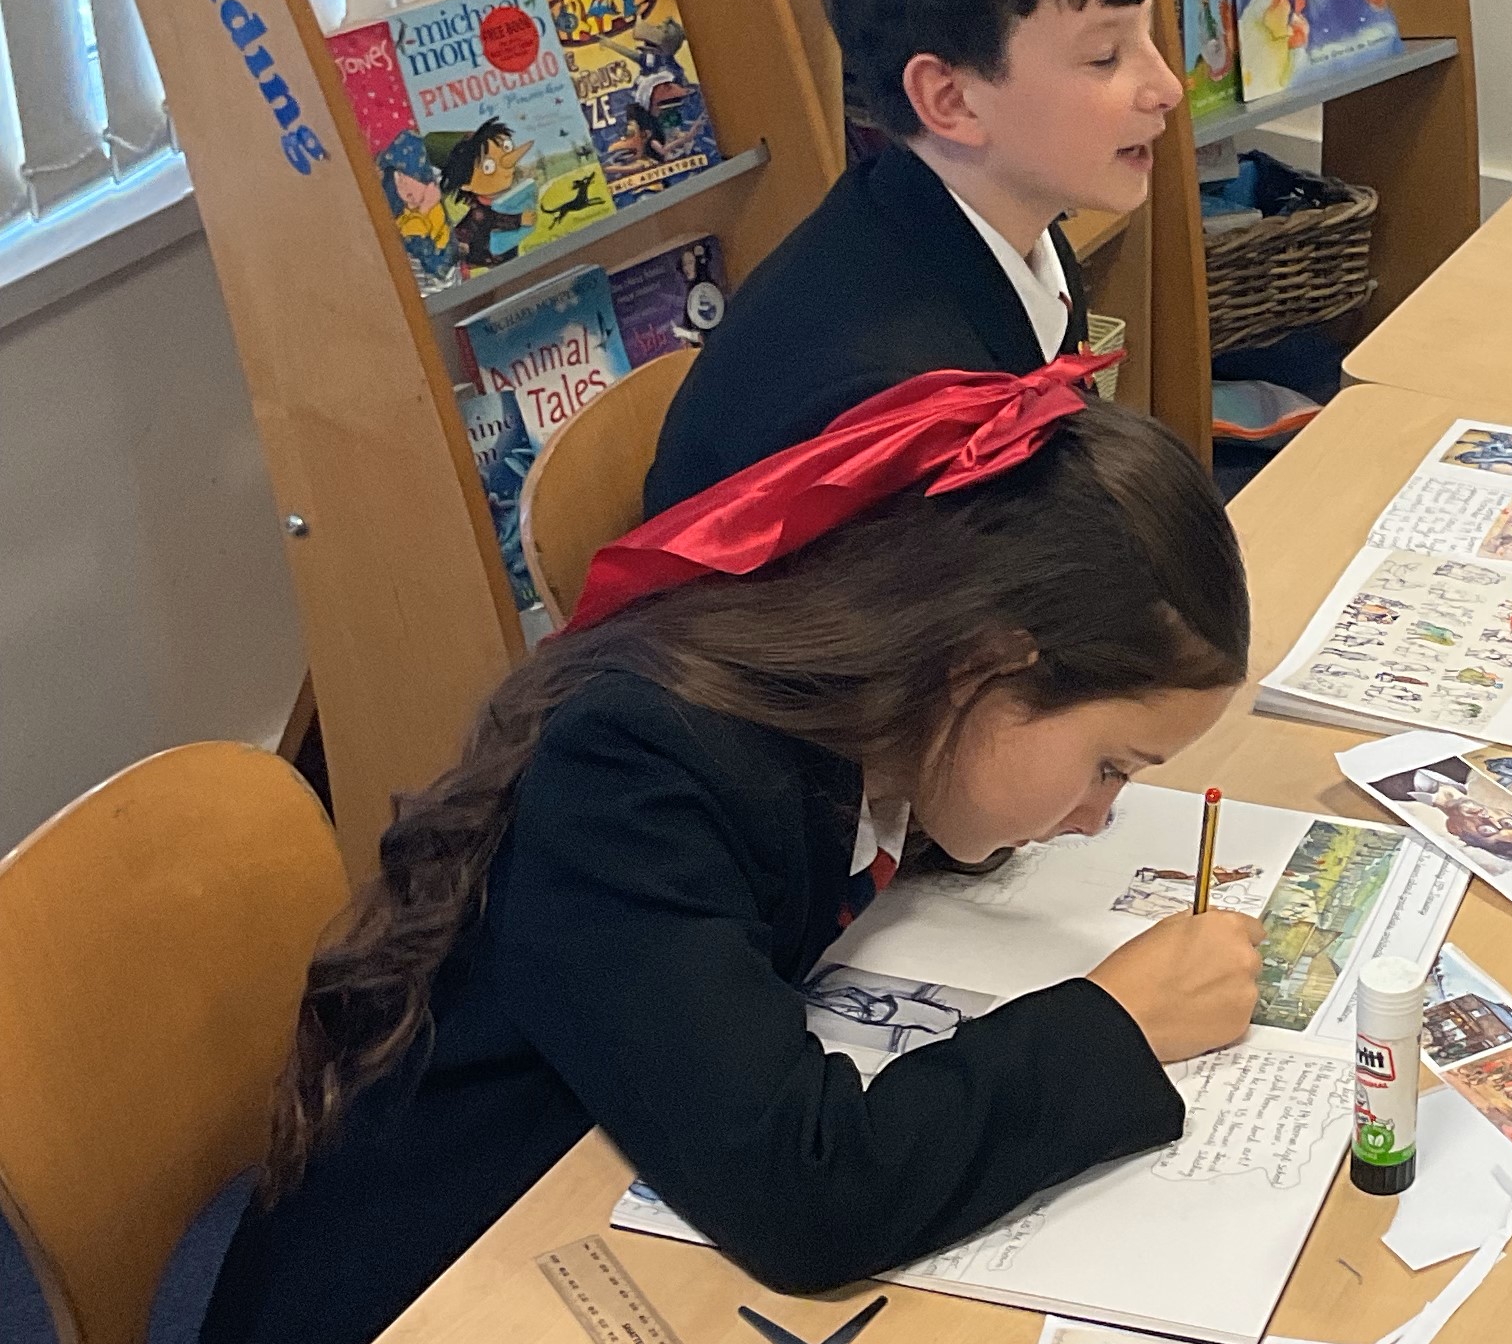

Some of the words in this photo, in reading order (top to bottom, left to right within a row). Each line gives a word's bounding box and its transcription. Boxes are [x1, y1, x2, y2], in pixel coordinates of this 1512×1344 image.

[408, 14, 547, 77] morpo
[419, 51, 560, 119] PINOCCHIO
[490, 325, 592, 395] Animal
[527, 368, 609, 428] Tales
[1357, 1045, 1385, 1069] ritt
